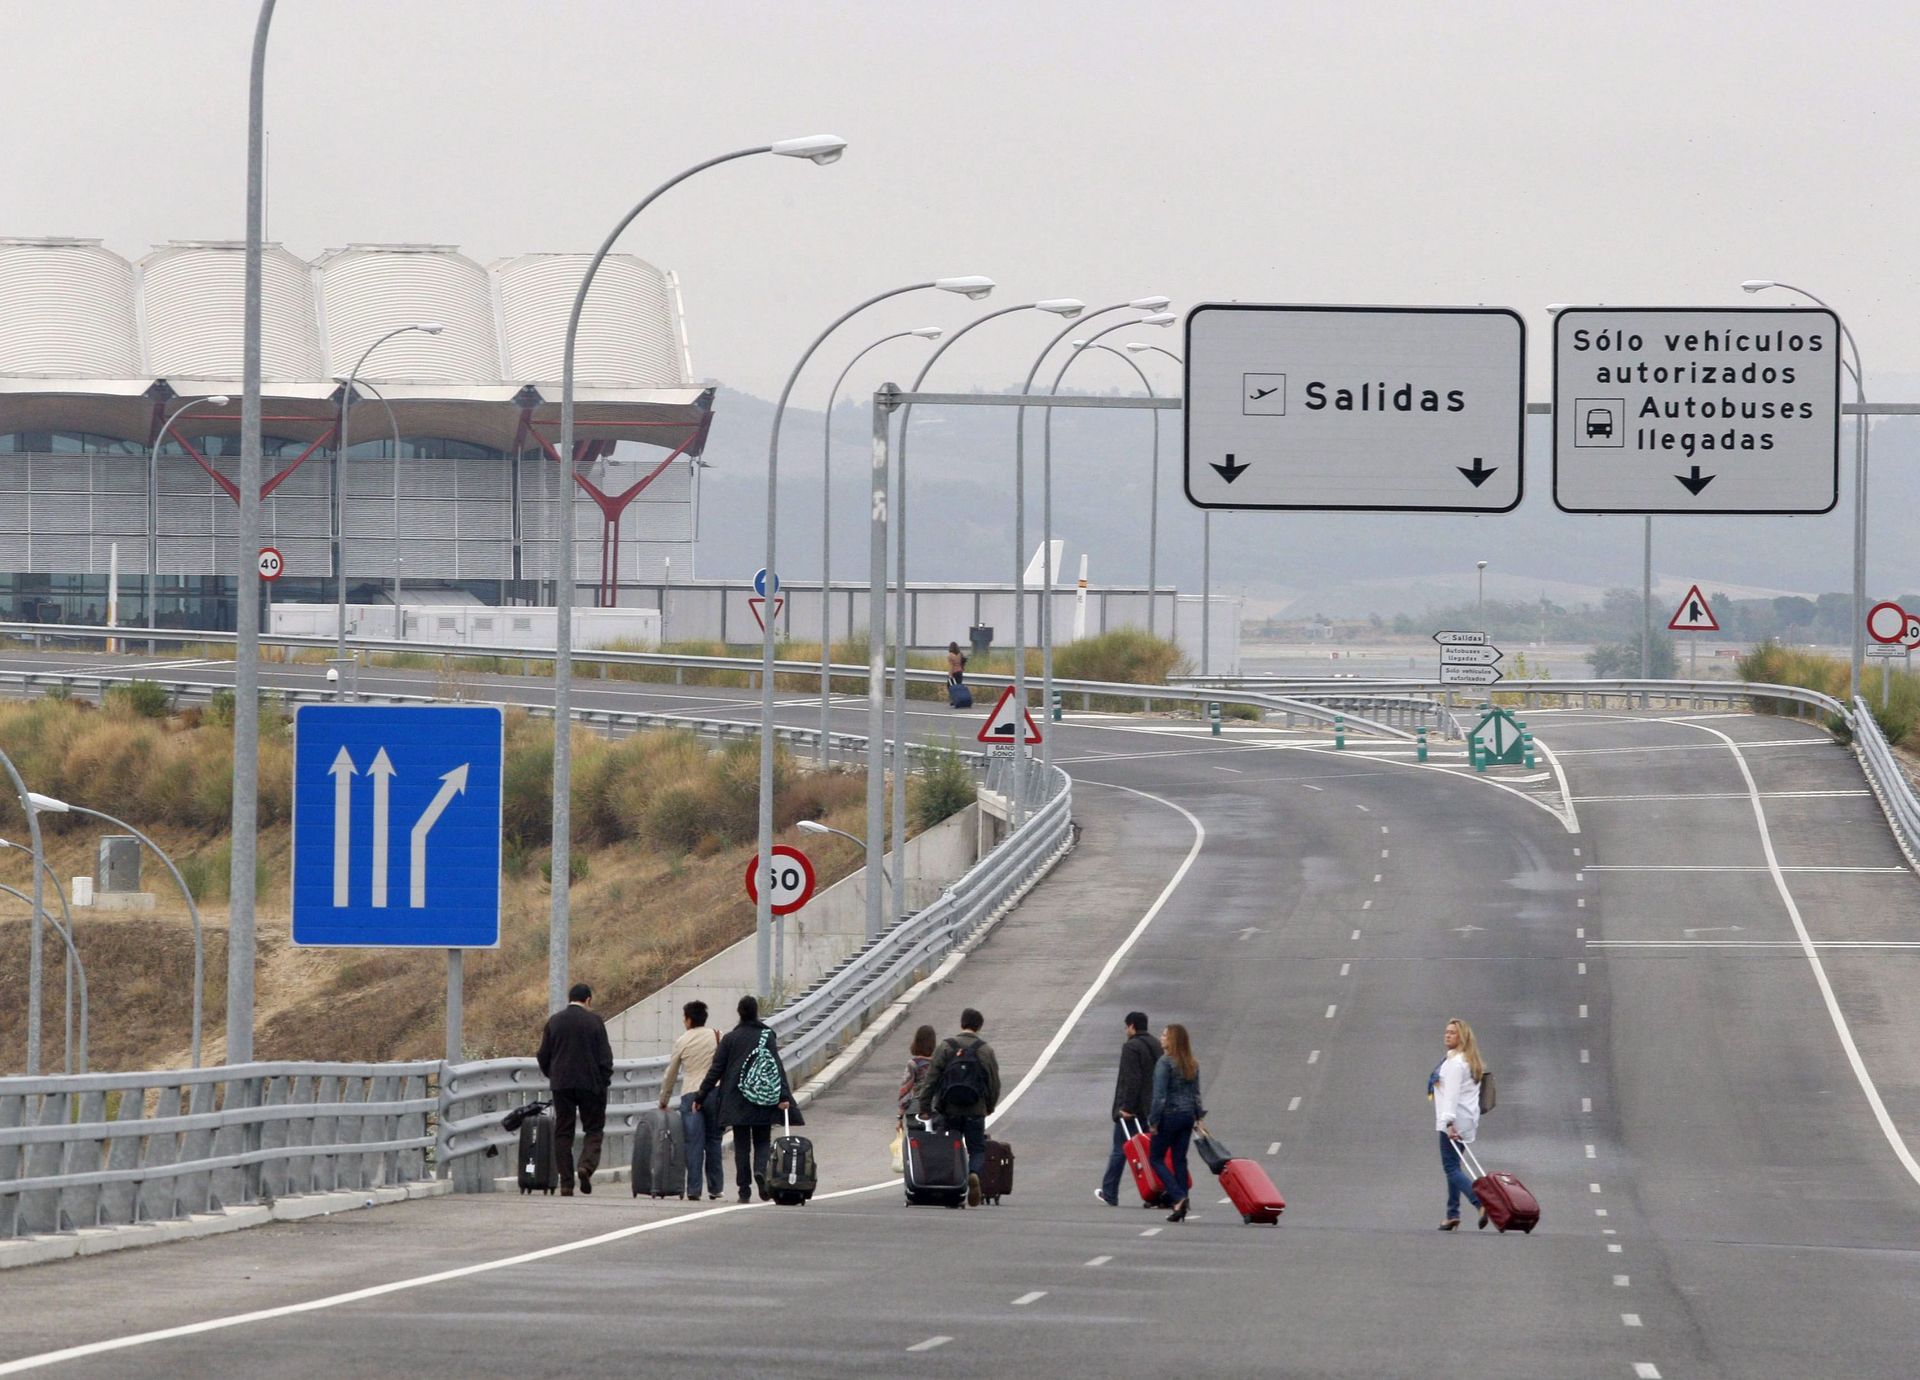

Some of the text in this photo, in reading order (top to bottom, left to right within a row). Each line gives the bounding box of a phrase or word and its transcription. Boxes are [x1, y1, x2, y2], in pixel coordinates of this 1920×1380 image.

[1573, 328, 1823, 352] Sólo vehículos
[1596, 361, 1796, 384] autorizados
[1304, 381, 1465, 413] Salidas
[1638, 396, 1813, 420] Autobuses
[1637, 428, 1774, 458] llegadas
[260, 558, 279, 570] 40
